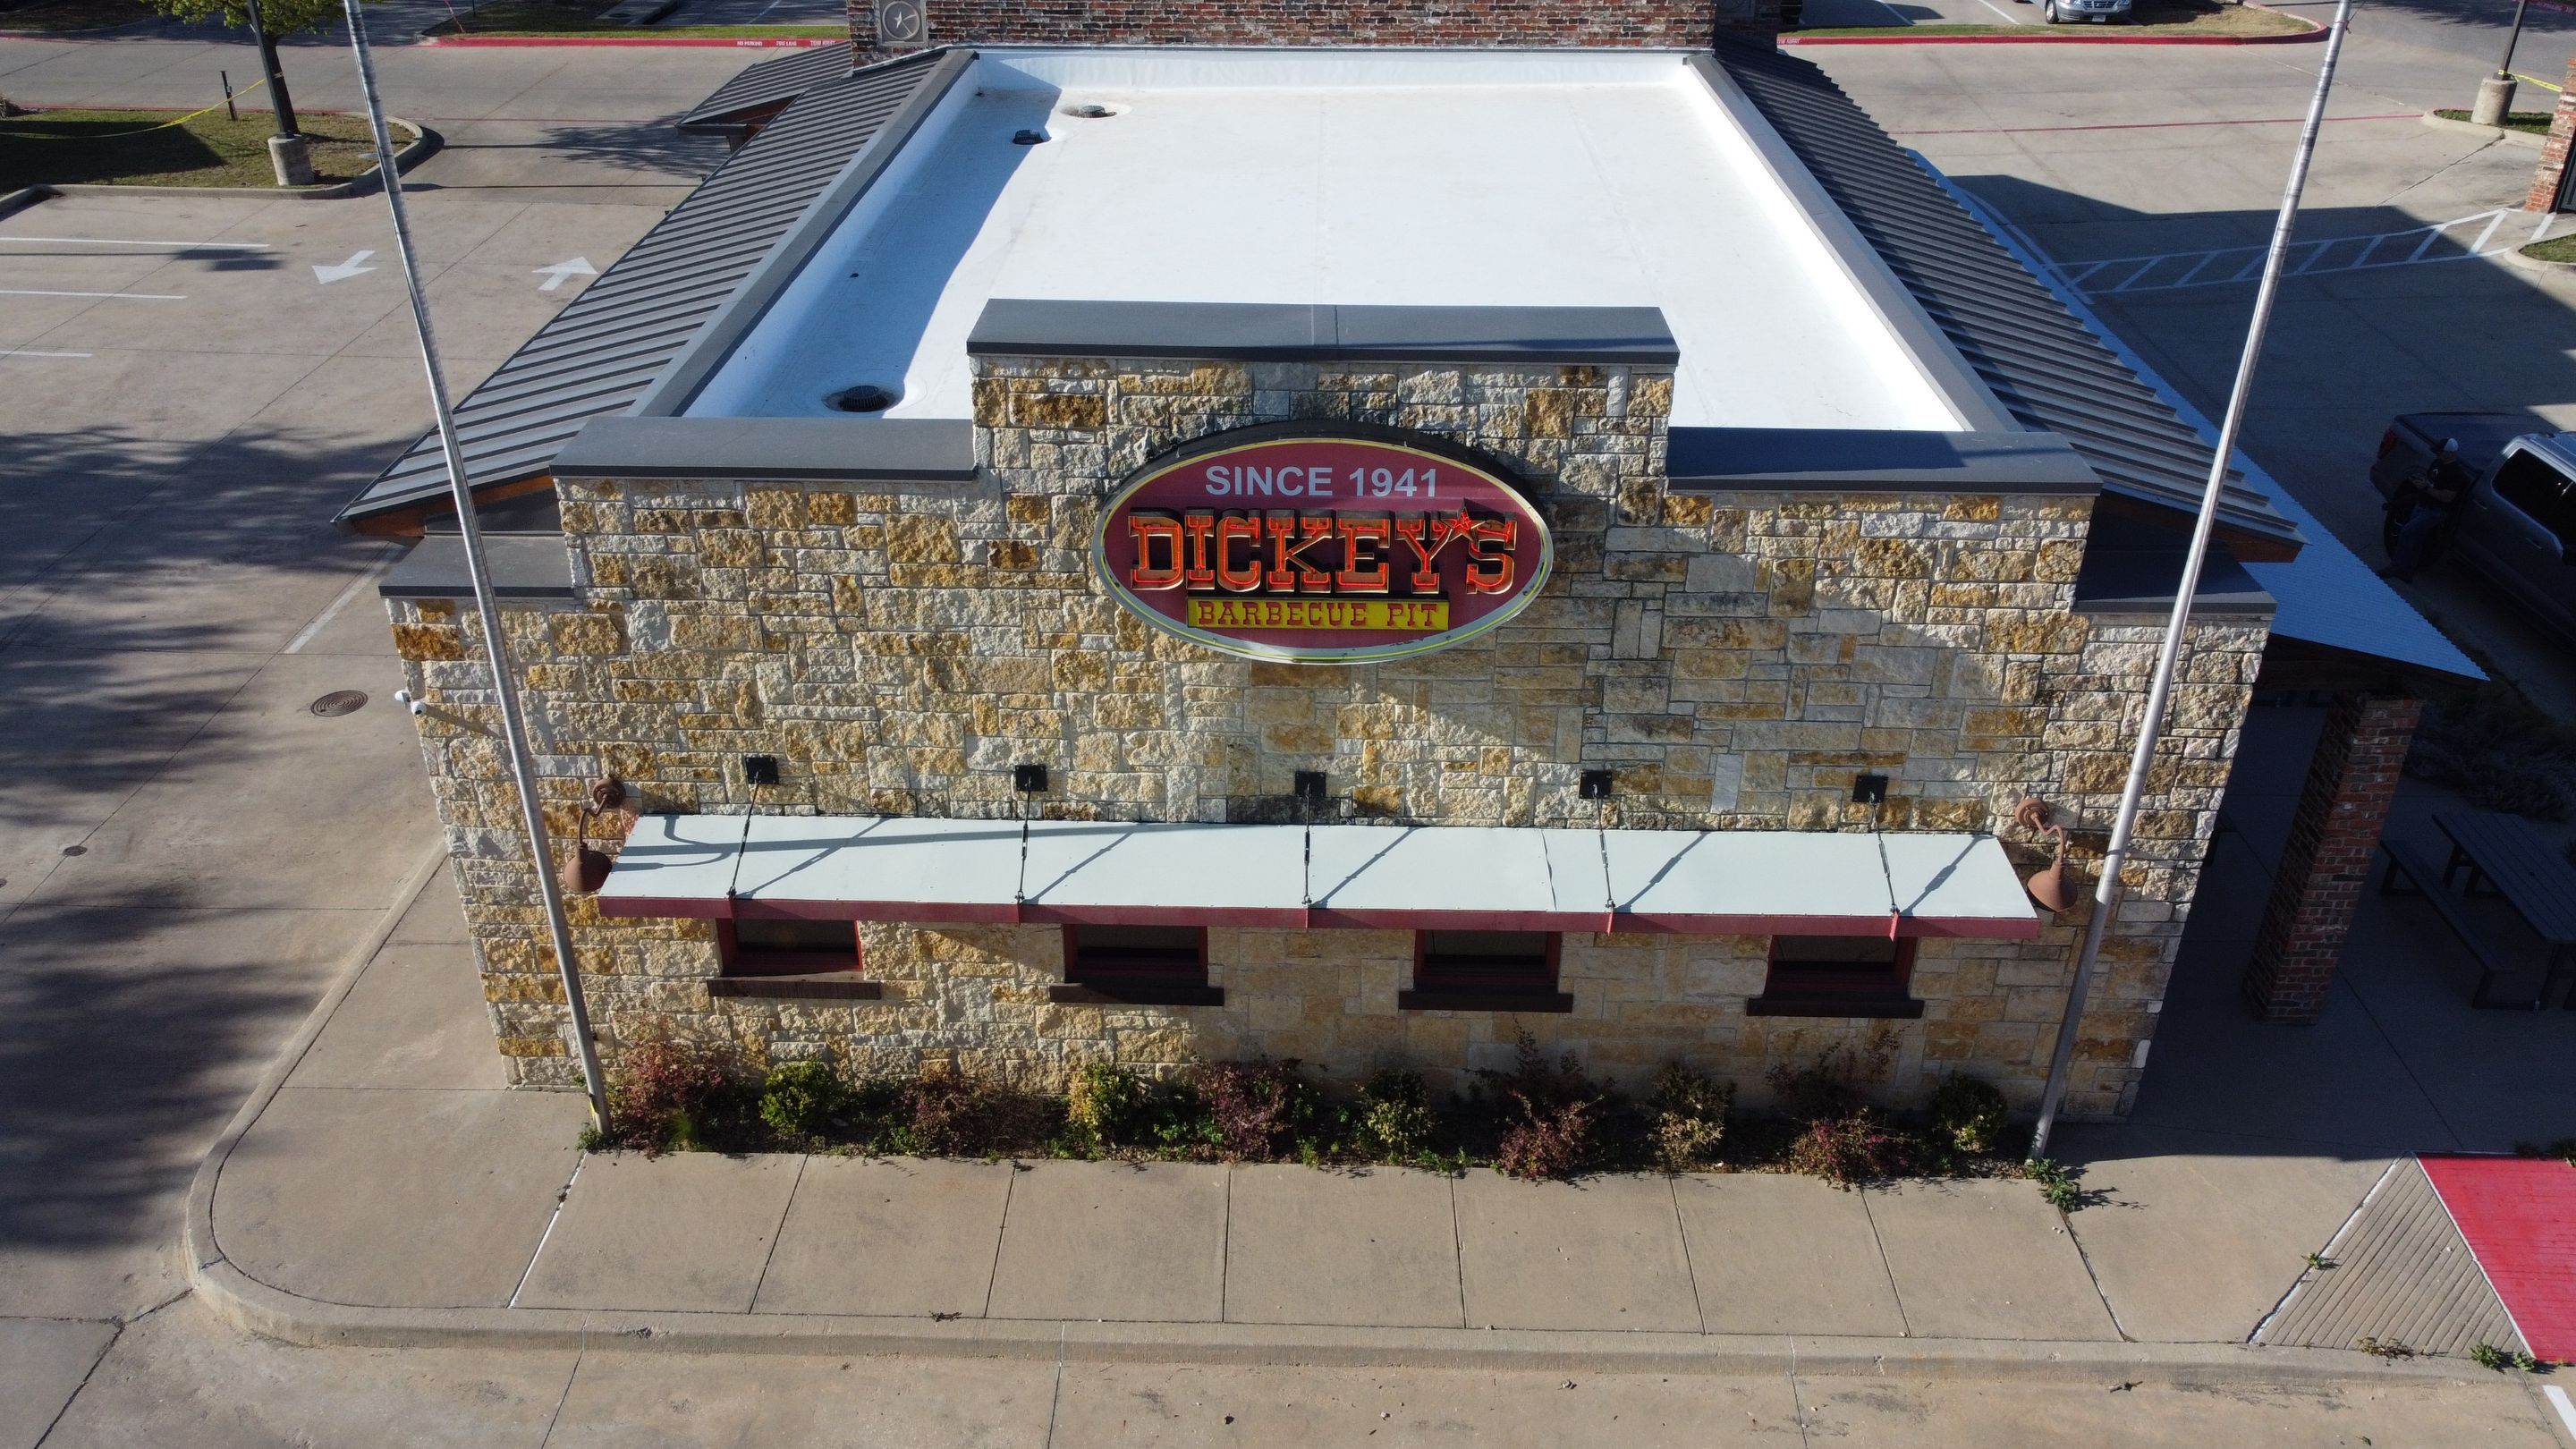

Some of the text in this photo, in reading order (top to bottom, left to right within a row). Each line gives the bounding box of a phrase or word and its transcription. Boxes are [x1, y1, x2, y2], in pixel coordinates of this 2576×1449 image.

[1205, 465, 1436, 498] SINCE 1941
[1198, 600, 1438, 627] BARBECUE PIT
